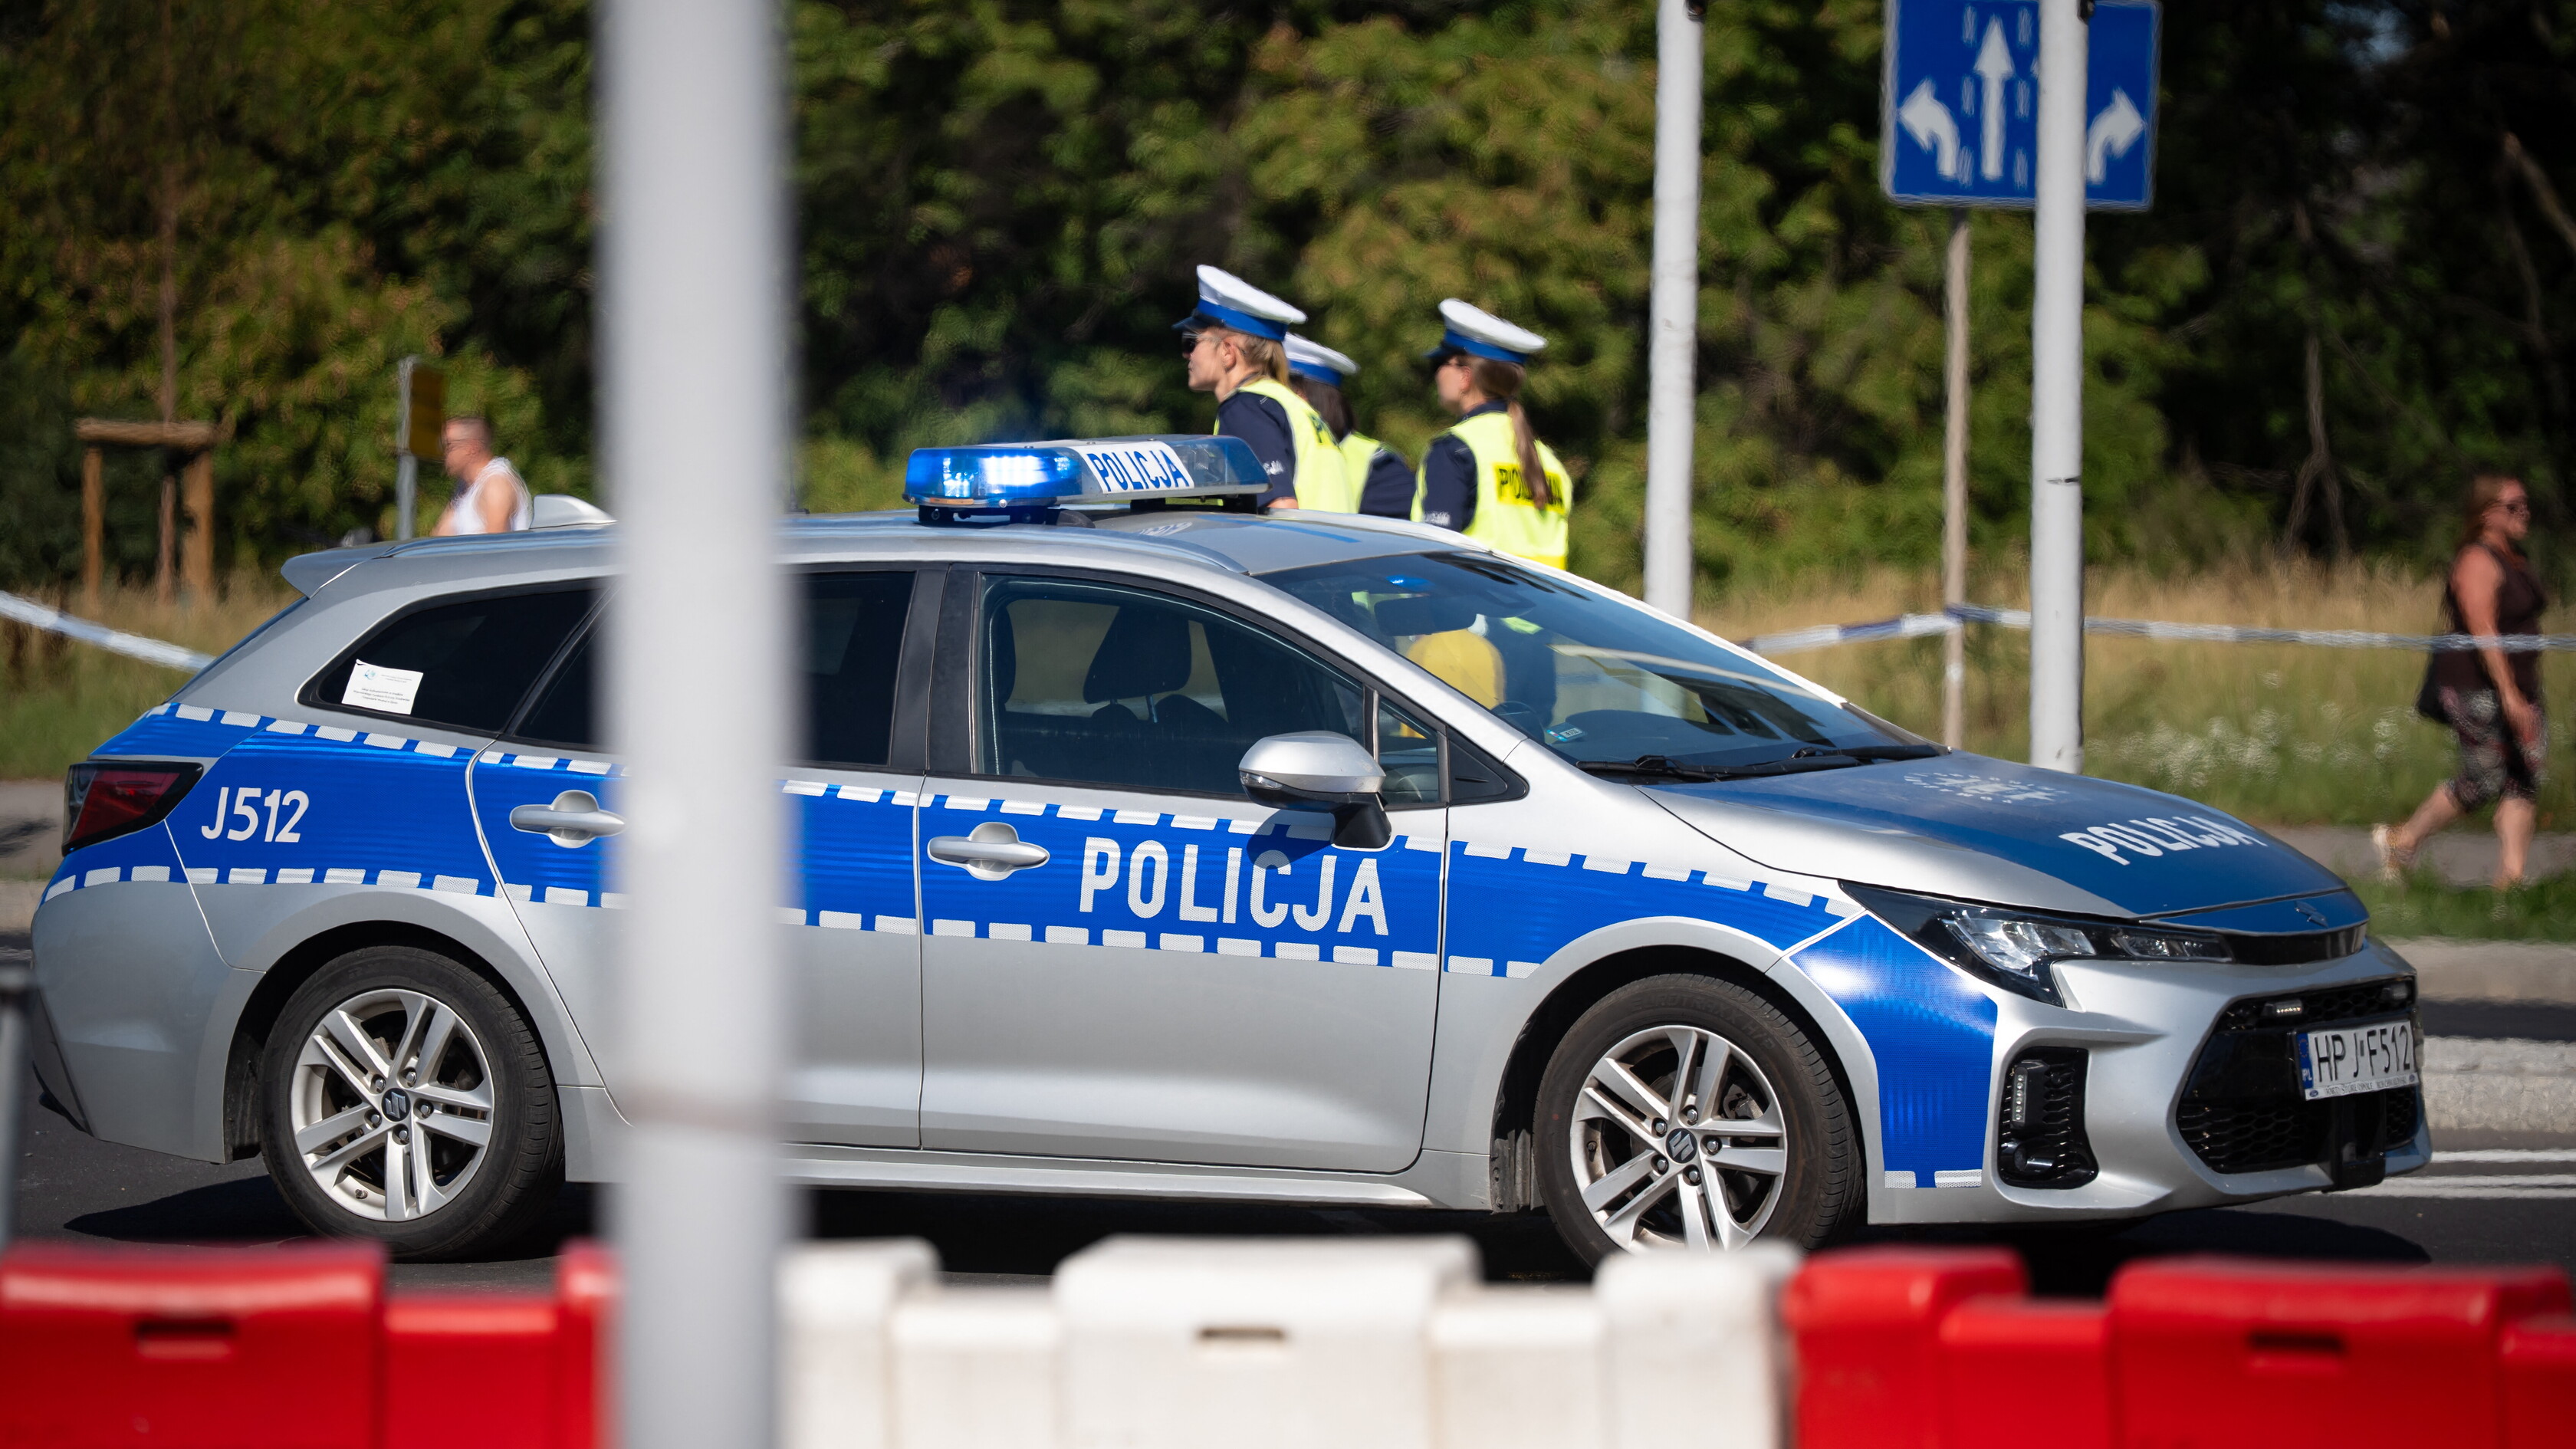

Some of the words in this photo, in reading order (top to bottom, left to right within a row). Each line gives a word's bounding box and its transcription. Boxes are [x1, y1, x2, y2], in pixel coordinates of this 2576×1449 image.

[1086, 449, 1189, 492] POLICJA
[201, 787, 310, 843] J512
[2058, 816, 2269, 866] POLICJA
[1079, 836, 1388, 935] POLICJA
[2302, 1068, 2312, 1082] PL
